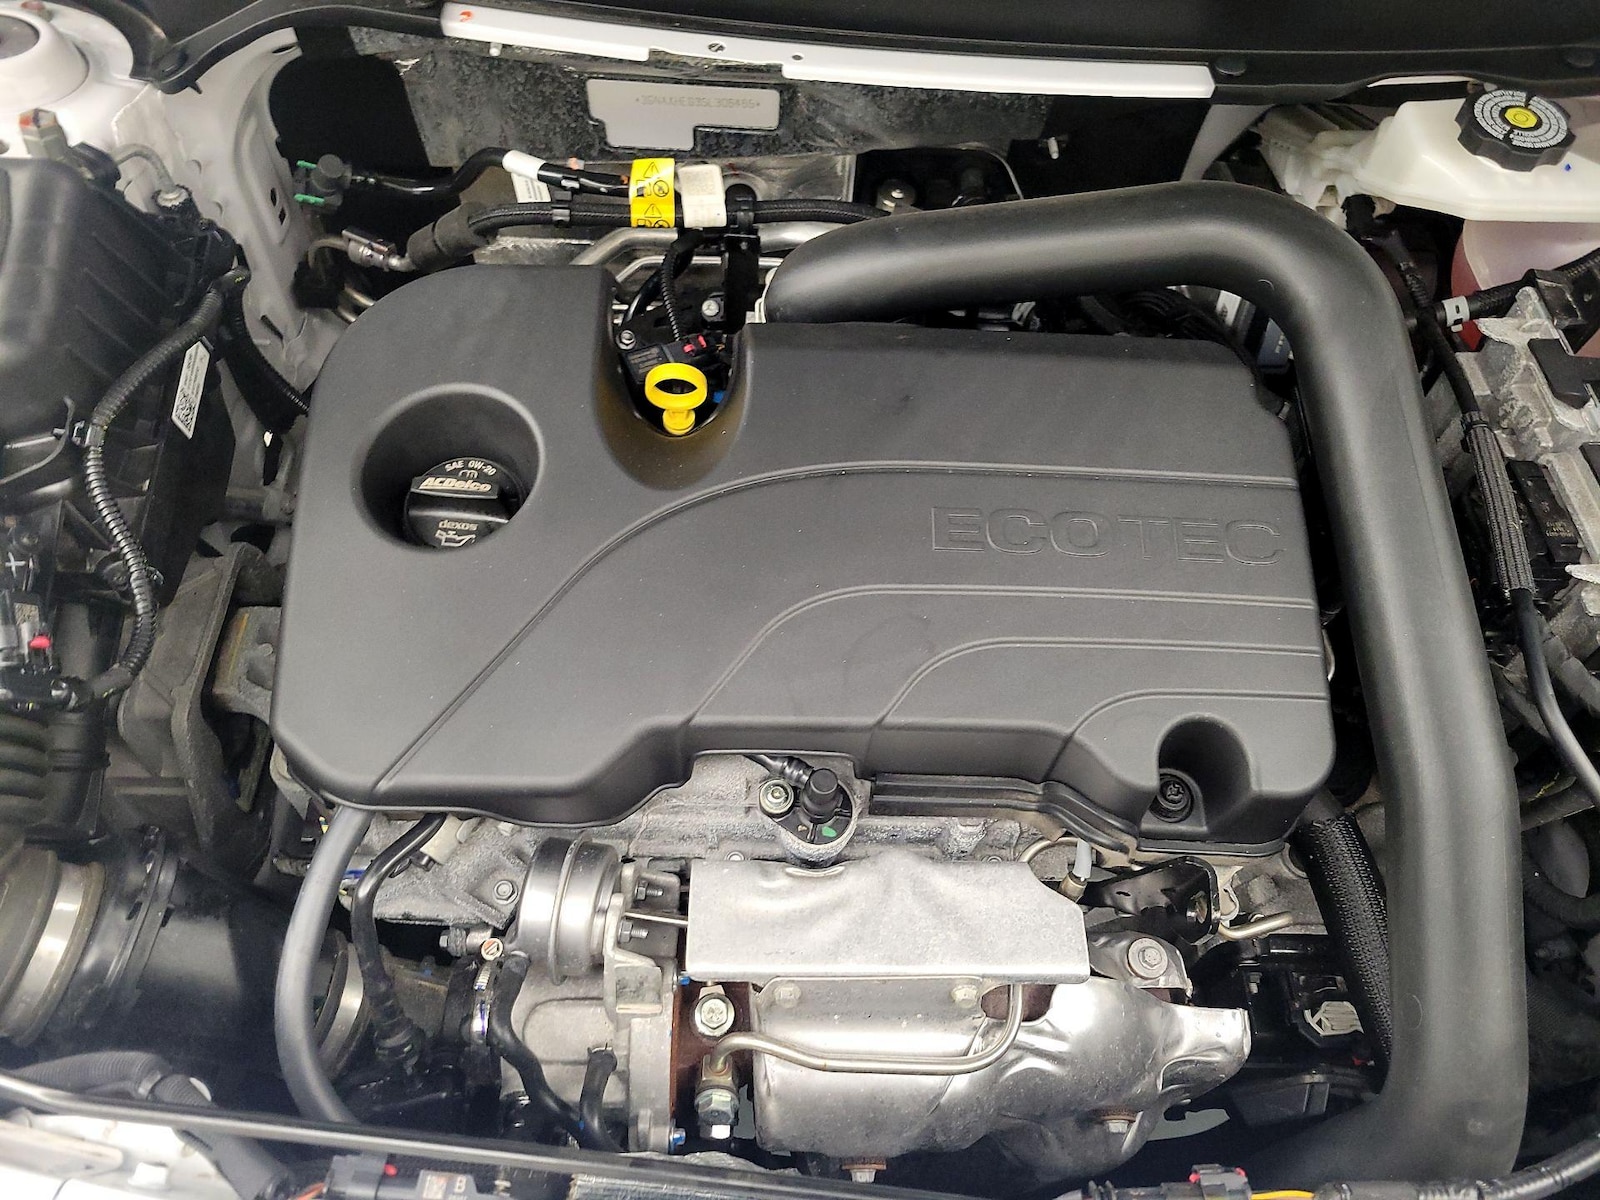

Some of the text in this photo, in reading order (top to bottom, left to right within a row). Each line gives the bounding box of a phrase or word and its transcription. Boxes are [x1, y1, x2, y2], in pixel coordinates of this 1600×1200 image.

[445, 460, 497, 476] SAE 0W-20
[419, 477, 492, 493] ACDelco
[439, 520, 478, 531] dexos
[931, 506, 1284, 566] ECOTEC
